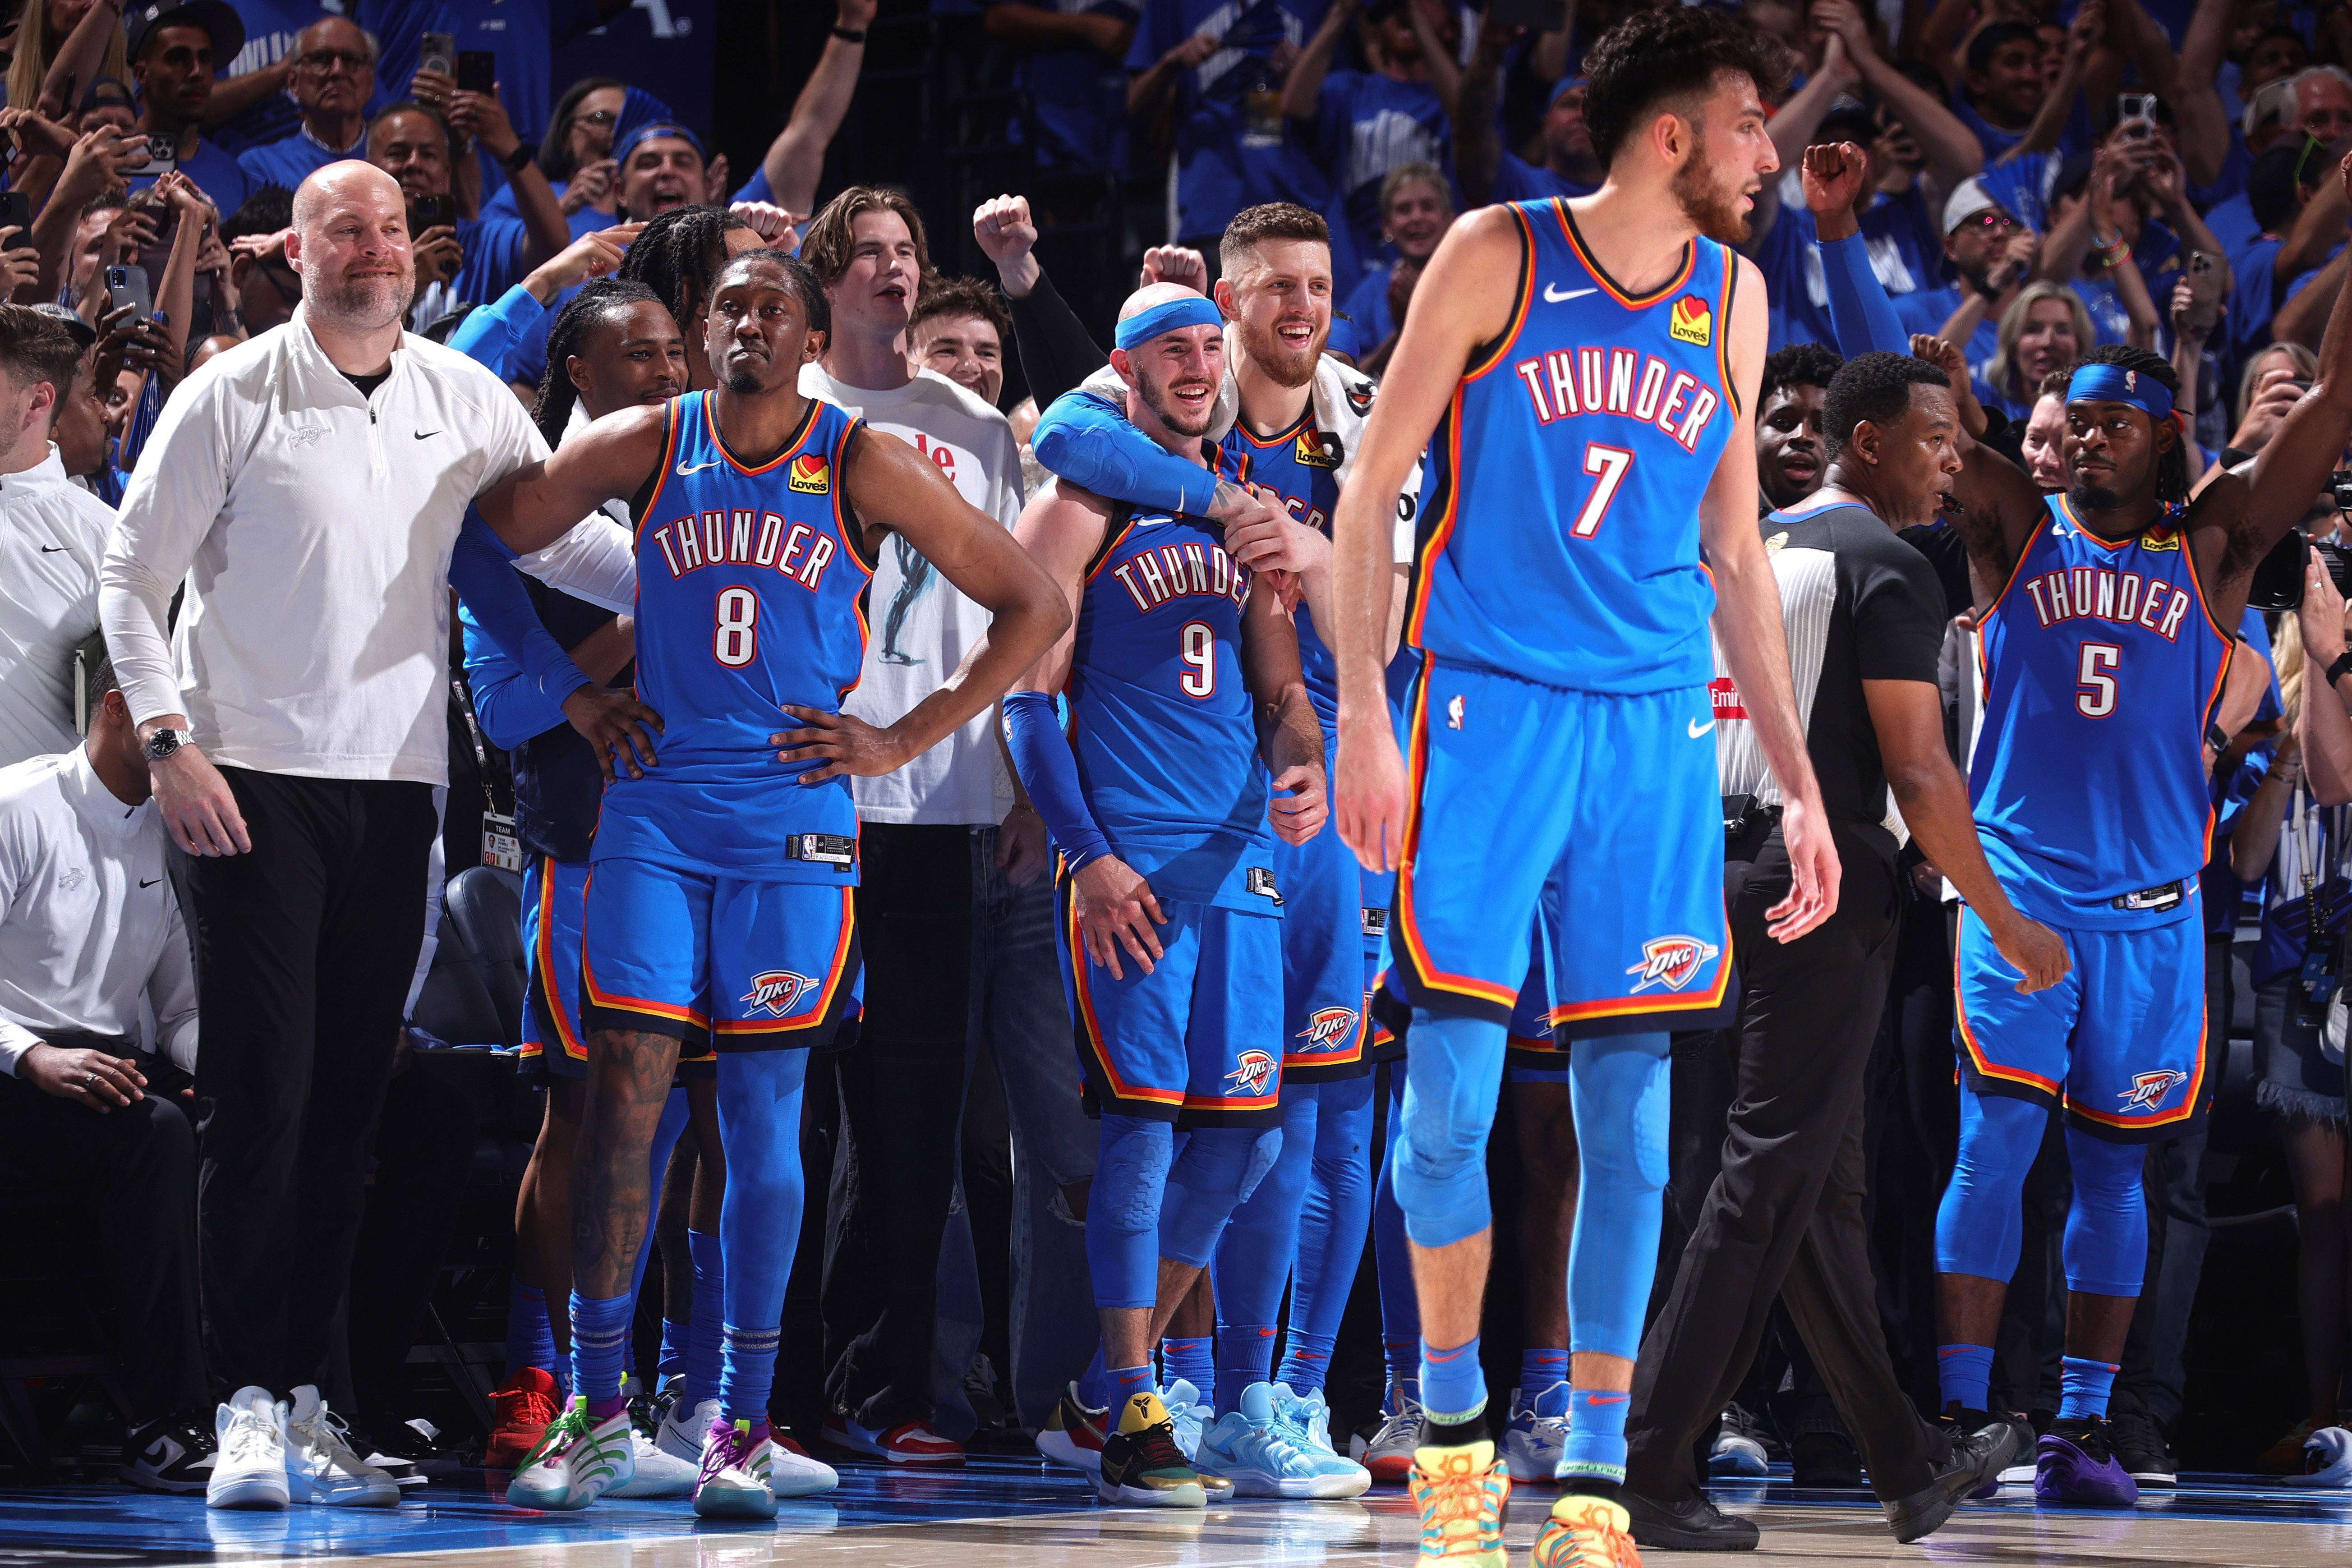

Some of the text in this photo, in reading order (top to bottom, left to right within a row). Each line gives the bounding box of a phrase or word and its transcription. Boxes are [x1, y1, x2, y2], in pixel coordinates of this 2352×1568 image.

[1514, 346, 1720, 455] THUNDER
[1570, 441, 1635, 539] 7
[652, 509, 837, 593] THUNDER
[713, 584, 759, 669] 8
[2024, 566, 2191, 644] THUNDER
[1180, 620, 1216, 699] 9
[2076, 641, 2122, 719] 5
[496, 825, 511, 835] TEAM
[753, 979, 794, 1007] OKC
[1646, 947, 1692, 979] OKC
[1312, 1015, 1347, 1042] OKC
[1239, 1060, 1267, 1084] OKC
[2132, 1077, 2169, 1103] OKC
